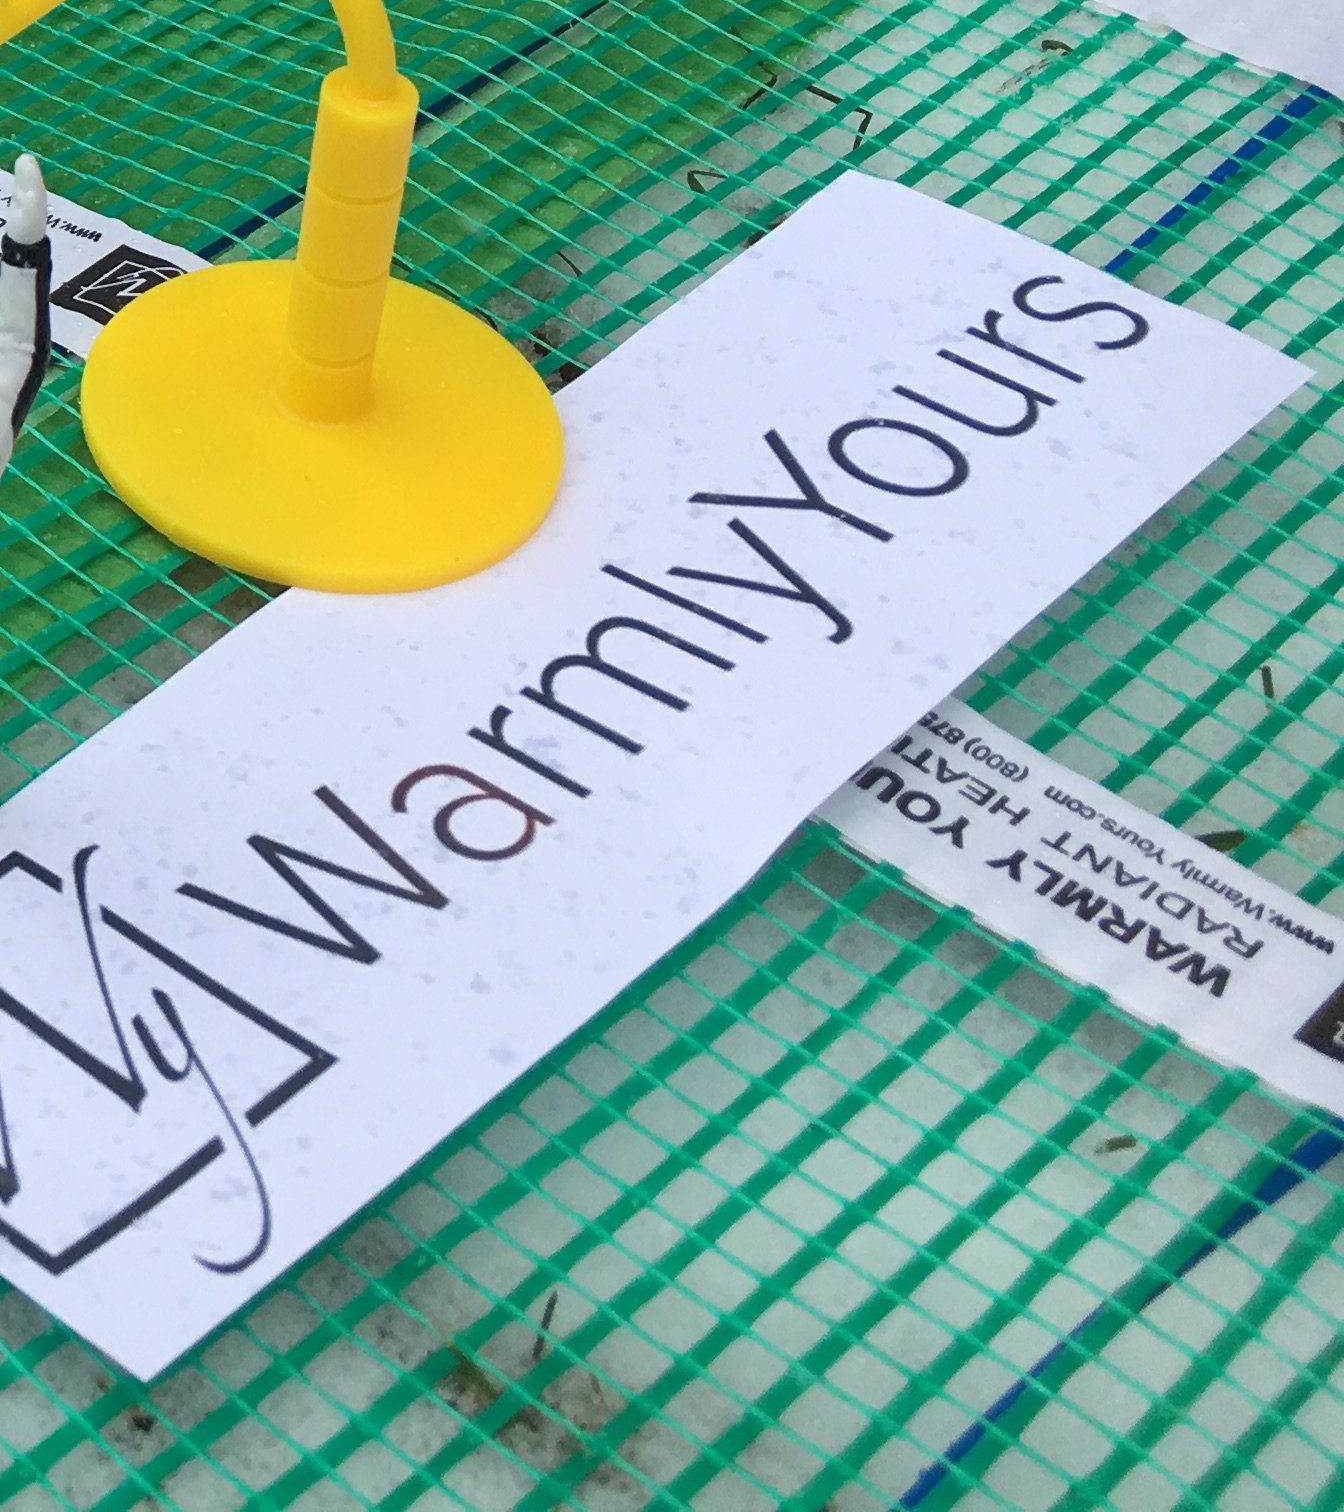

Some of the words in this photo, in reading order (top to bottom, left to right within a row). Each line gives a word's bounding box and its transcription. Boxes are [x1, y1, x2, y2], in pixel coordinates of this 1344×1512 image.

[174, 274, 1151, 966] WarmlyYours
[986, 850, 1231, 998] WARMLY
[1041, 831, 1264, 960] RADIANT
